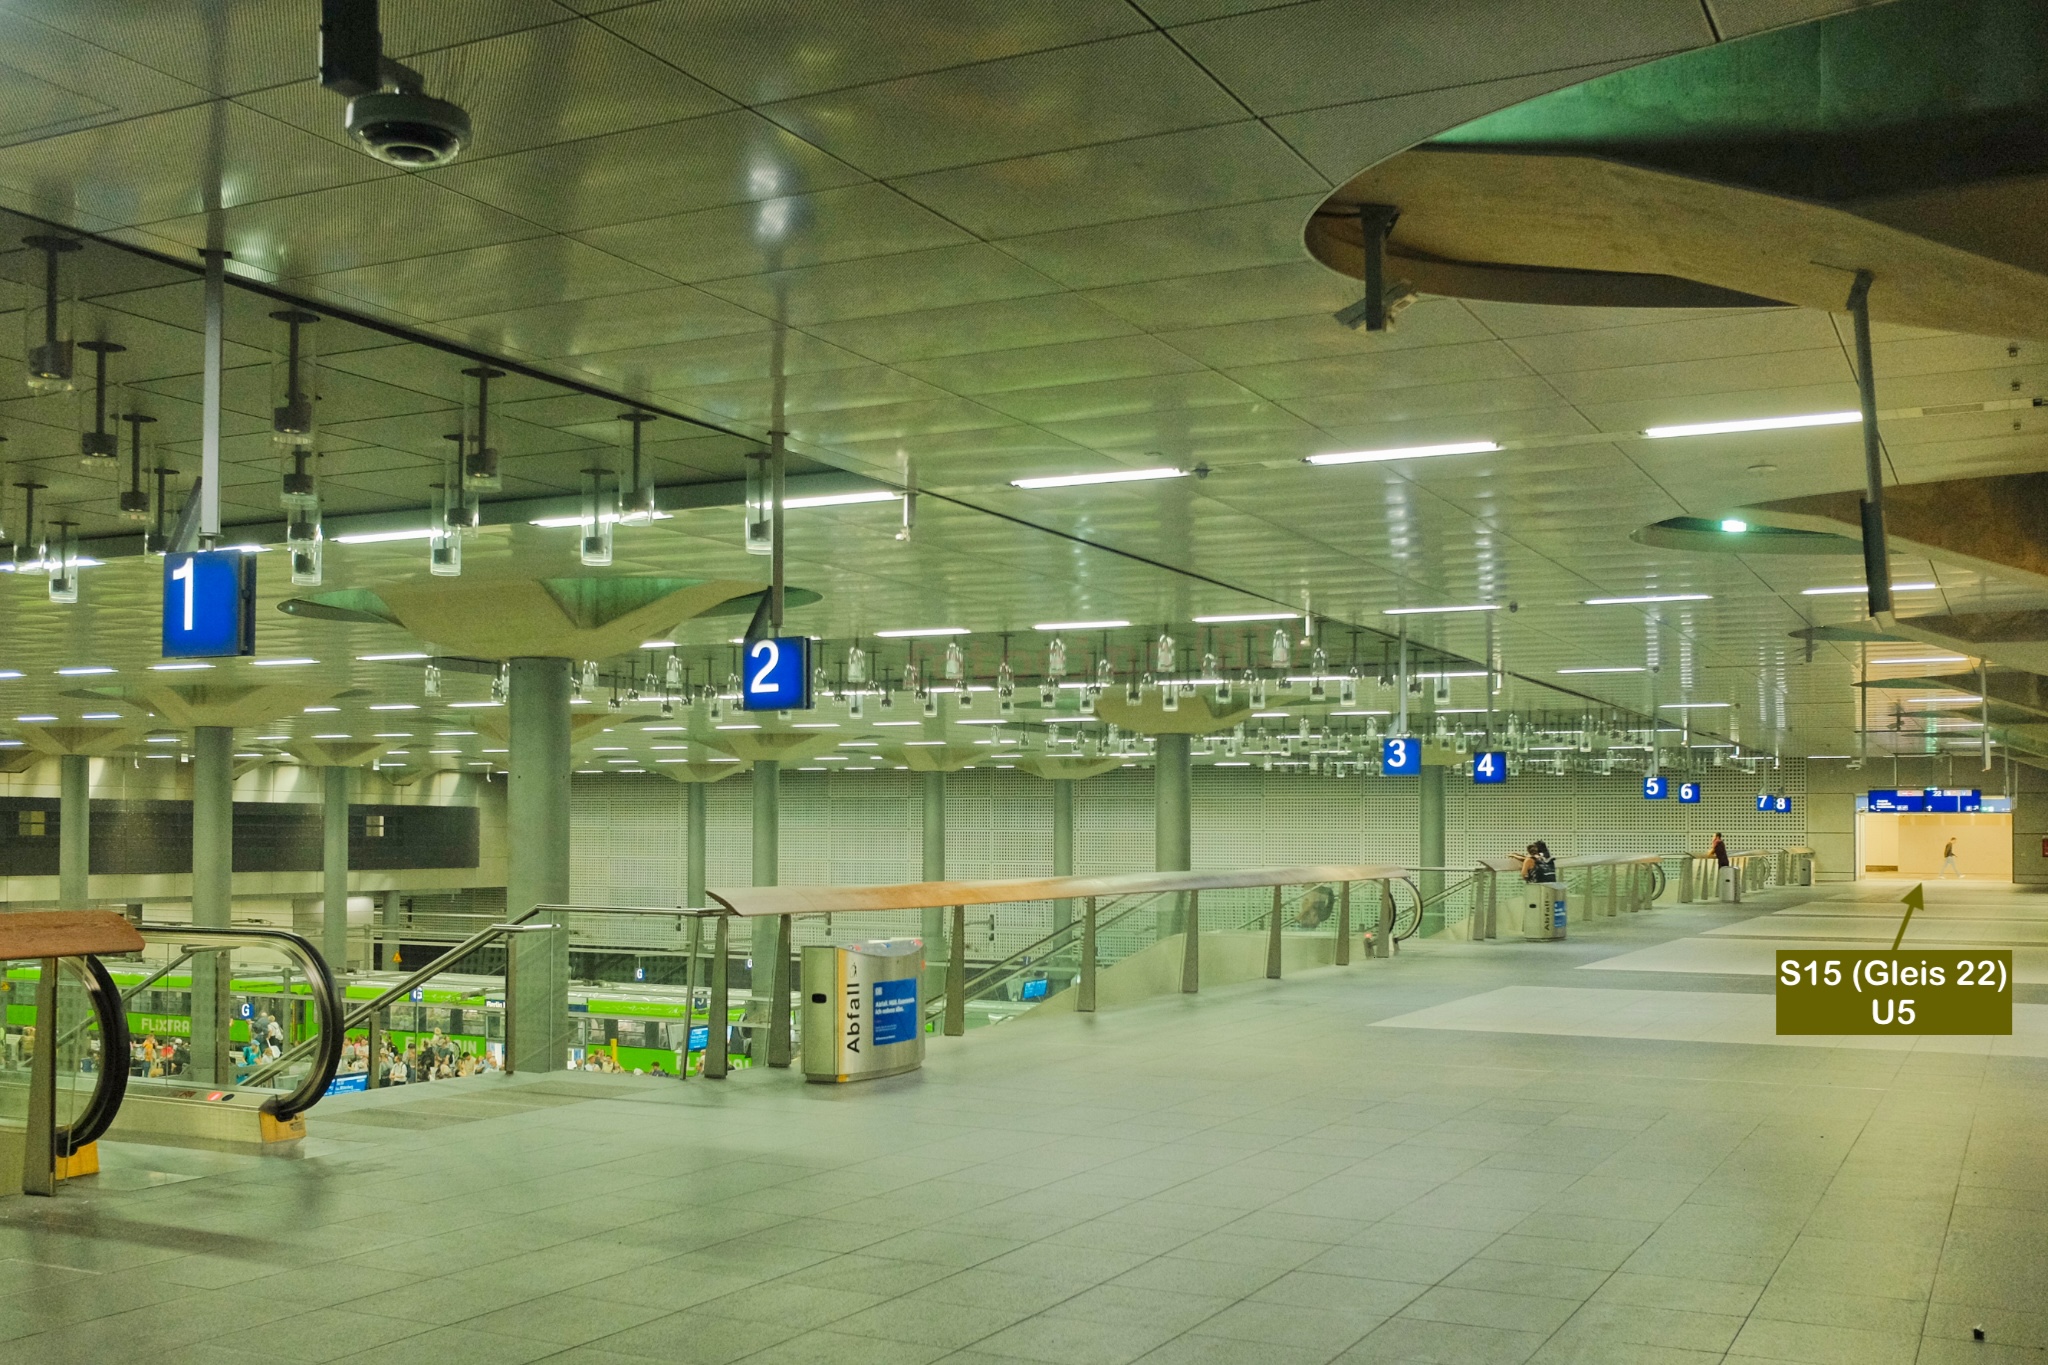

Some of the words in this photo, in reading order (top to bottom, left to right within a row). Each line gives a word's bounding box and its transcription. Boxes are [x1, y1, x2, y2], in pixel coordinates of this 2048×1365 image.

[172, 557, 194, 631] 1
[750, 639, 779, 694] 2
[1387, 739, 1407, 768] 3
[1477, 753, 1495, 777] 4
[1646, 777, 1659, 795] 5
[1680, 783, 1693, 800] 6
[1757, 795, 1768, 808] 7
[1776, 797, 1786, 810] 8
[636, 968, 643, 979] G
[241, 1003, 250, 1017] G
[846, 982, 860, 1054] Abfall
